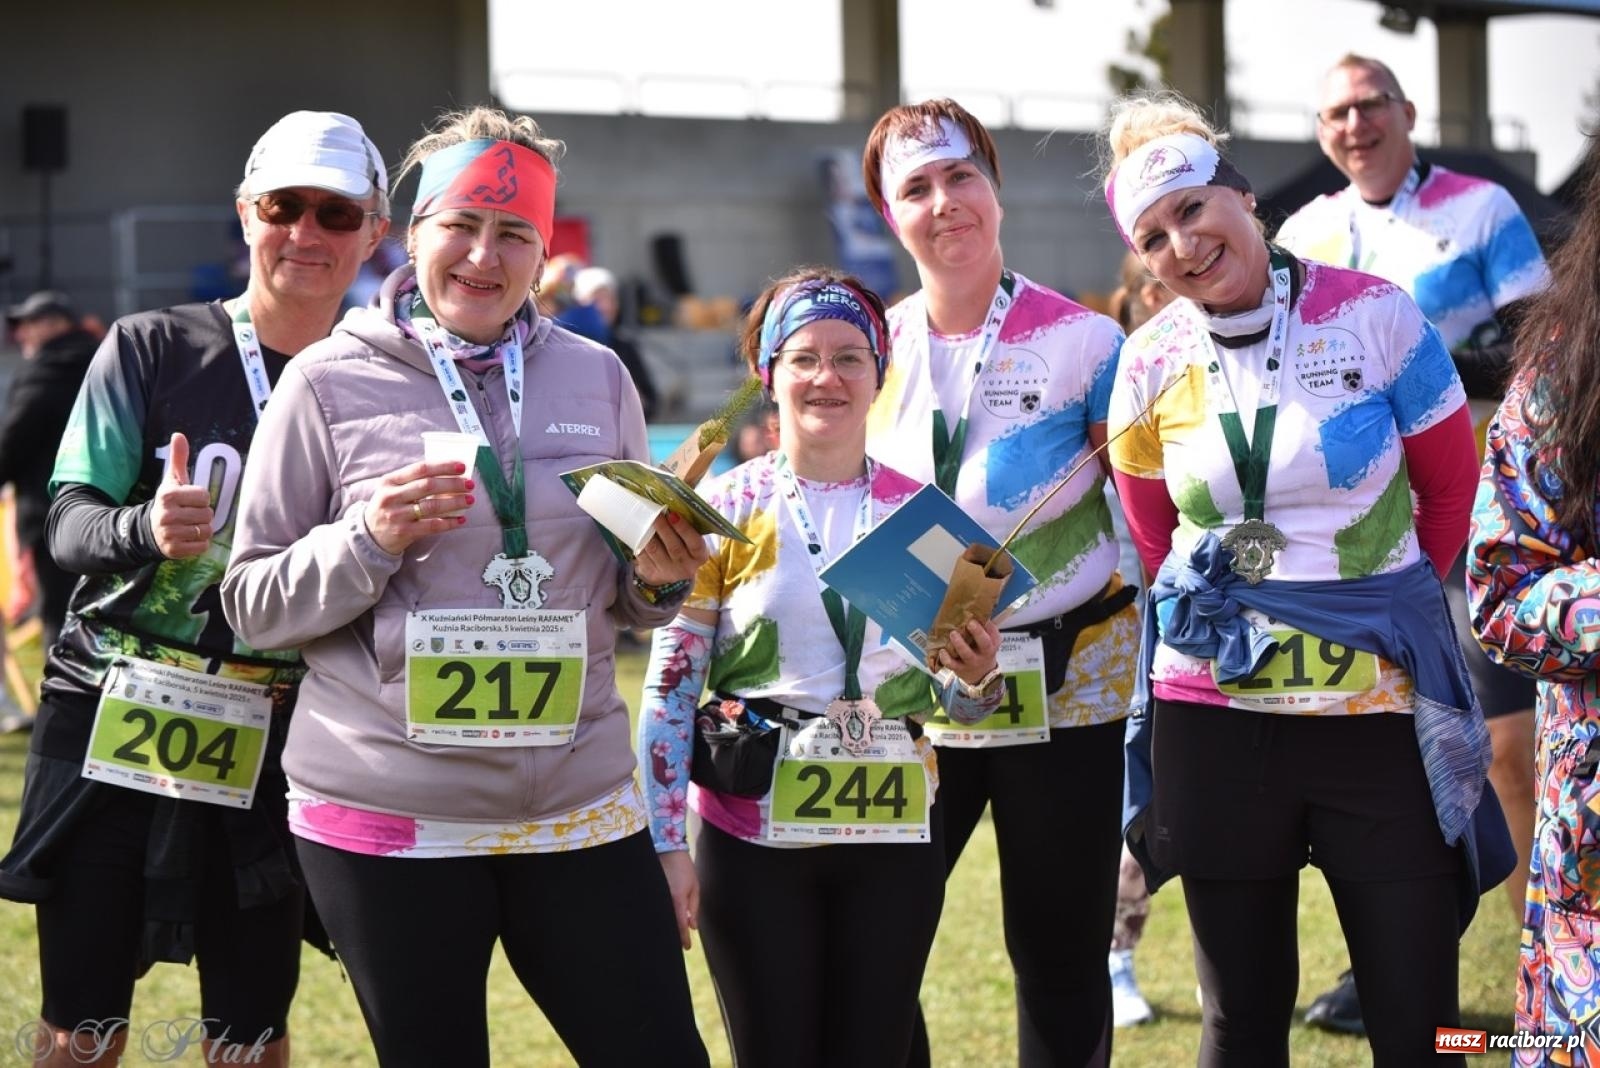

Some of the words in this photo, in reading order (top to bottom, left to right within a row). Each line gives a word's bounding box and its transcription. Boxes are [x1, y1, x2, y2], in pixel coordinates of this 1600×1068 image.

[816, 293, 861, 311] HERO
[1301, 368, 1339, 380] RUNNING
[1308, 379, 1334, 389] TEAM
[984, 389, 1019, 397] RUNNING
[989, 399, 1012, 407] TEAM
[559, 423, 601, 437] TERREX
[473, 614, 516, 623] Półmaraton
[518, 614, 537, 623] Leśny
[538, 615, 573, 623] RAFAMET
[432, 624, 459, 632] Kuźnia
[504, 624, 509, 632] 5
[510, 624, 540, 633] kwietnia
[541, 625, 559, 633] 2025
[435, 661, 562, 719] 217
[112, 708, 238, 780] 204
[794, 765, 908, 818] 244
